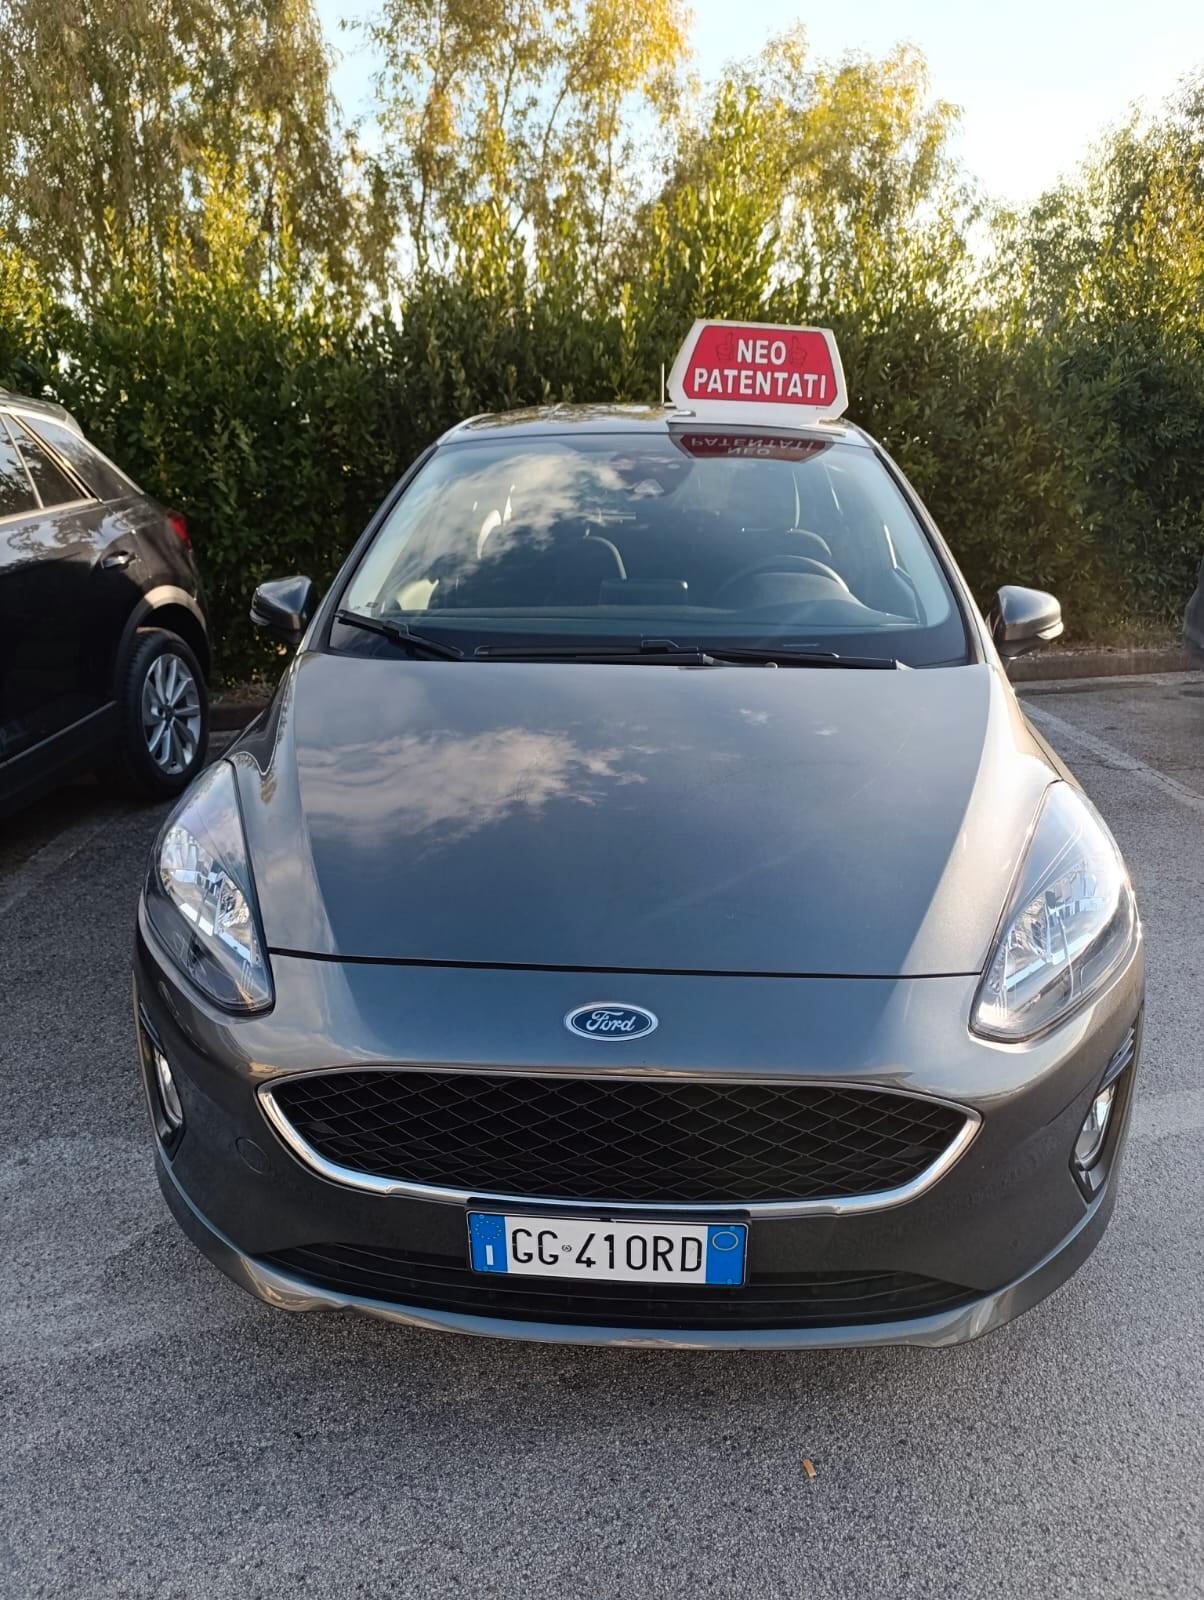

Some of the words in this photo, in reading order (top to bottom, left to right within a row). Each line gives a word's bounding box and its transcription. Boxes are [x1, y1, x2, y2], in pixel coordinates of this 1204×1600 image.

[737, 339, 787, 365] NEO
[693, 367, 826, 399] PATENTATI
[586, 1011, 636, 1031] Ford
